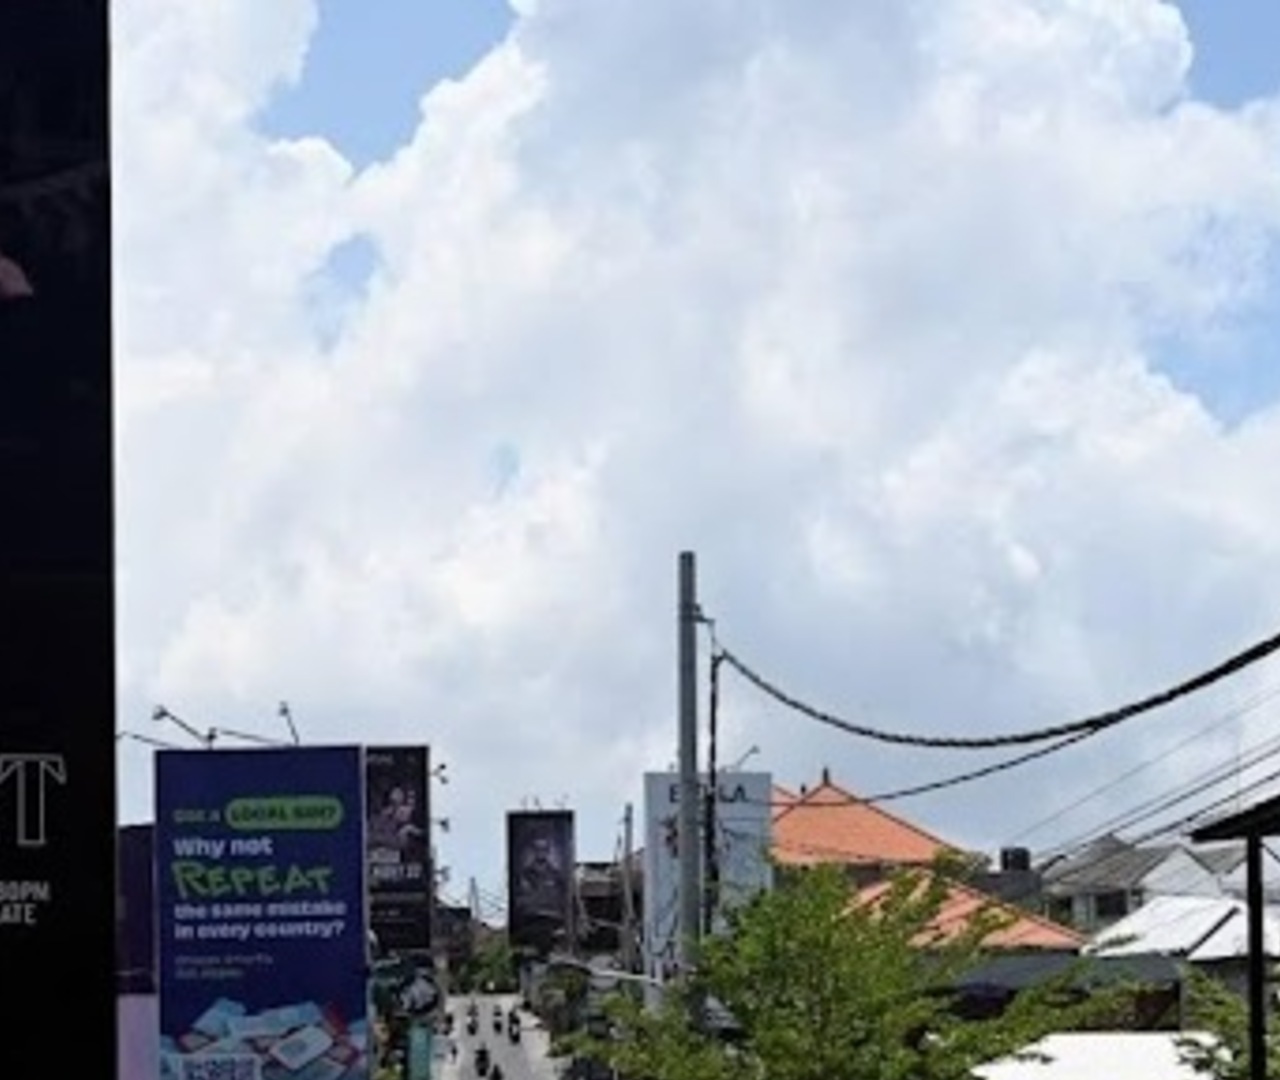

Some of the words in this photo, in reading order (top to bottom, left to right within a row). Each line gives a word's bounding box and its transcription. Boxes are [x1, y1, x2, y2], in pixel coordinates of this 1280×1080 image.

[172, 837, 225, 860] Why
[230, 836, 274, 856] not
[171, 861, 334, 900] REPEAT
[174, 903, 207, 919] the
[211, 902, 262, 918] same
[266, 900, 347, 916] mistake
[174, 923, 194, 940] in
[197, 923, 251, 942] every
[254, 920, 346, 939] country?
